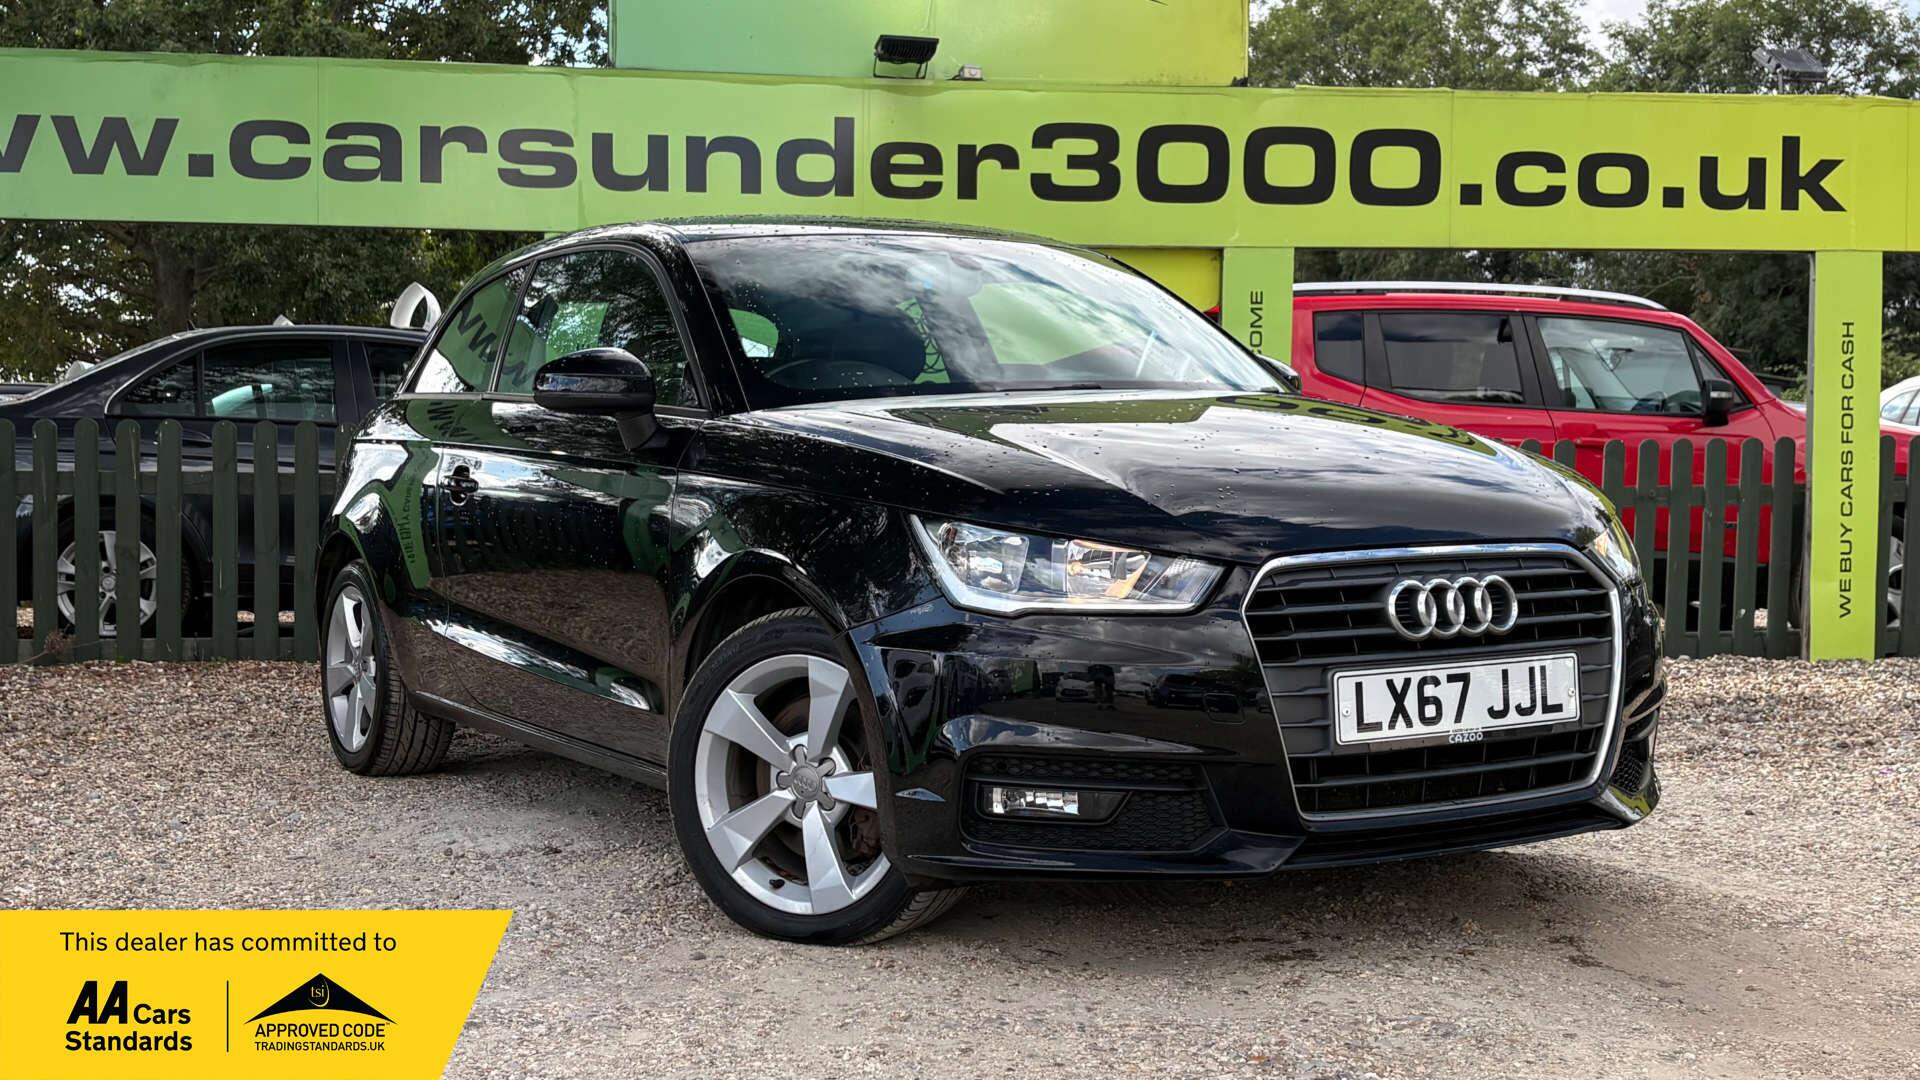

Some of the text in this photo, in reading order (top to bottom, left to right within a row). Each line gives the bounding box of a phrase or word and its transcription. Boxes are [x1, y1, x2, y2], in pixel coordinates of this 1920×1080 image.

[1250, 291, 1263, 355] OME
[1839, 322, 1855, 619] WE BUY CARS FOR CASH
[1354, 665, 1564, 734] LX67 JJL
[1449, 732, 1484, 744] CAZOO
